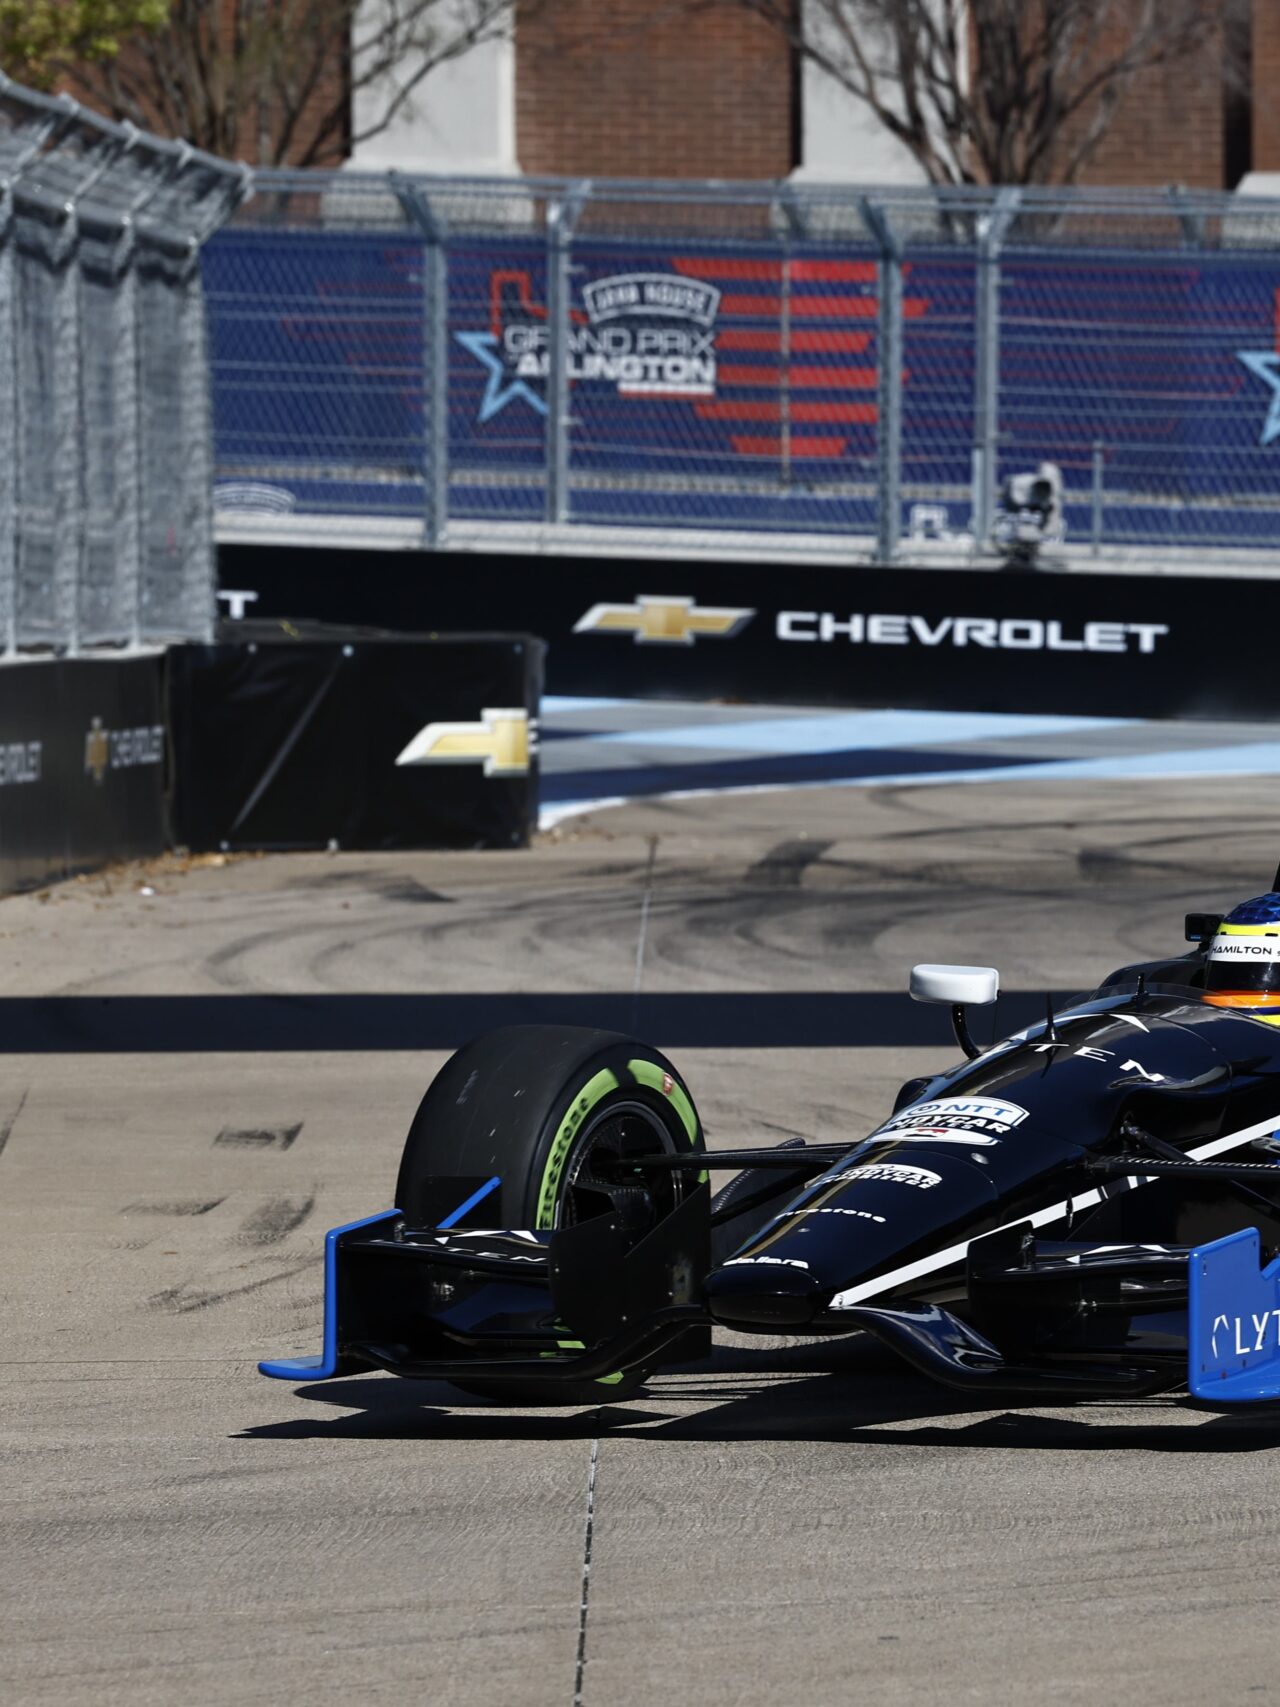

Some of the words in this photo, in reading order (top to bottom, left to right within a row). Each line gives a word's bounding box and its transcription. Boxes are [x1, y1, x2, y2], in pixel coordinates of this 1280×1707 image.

[644, 282, 706, 313] HOUSE
[635, 327, 716, 357] PRIX
[516, 352, 717, 382] ALINGTON
[775, 610, 1169, 653] CHEVROLET
[1211, 945, 1273, 956] HAMILTON
[943, 1104, 1013, 1117] NTT
